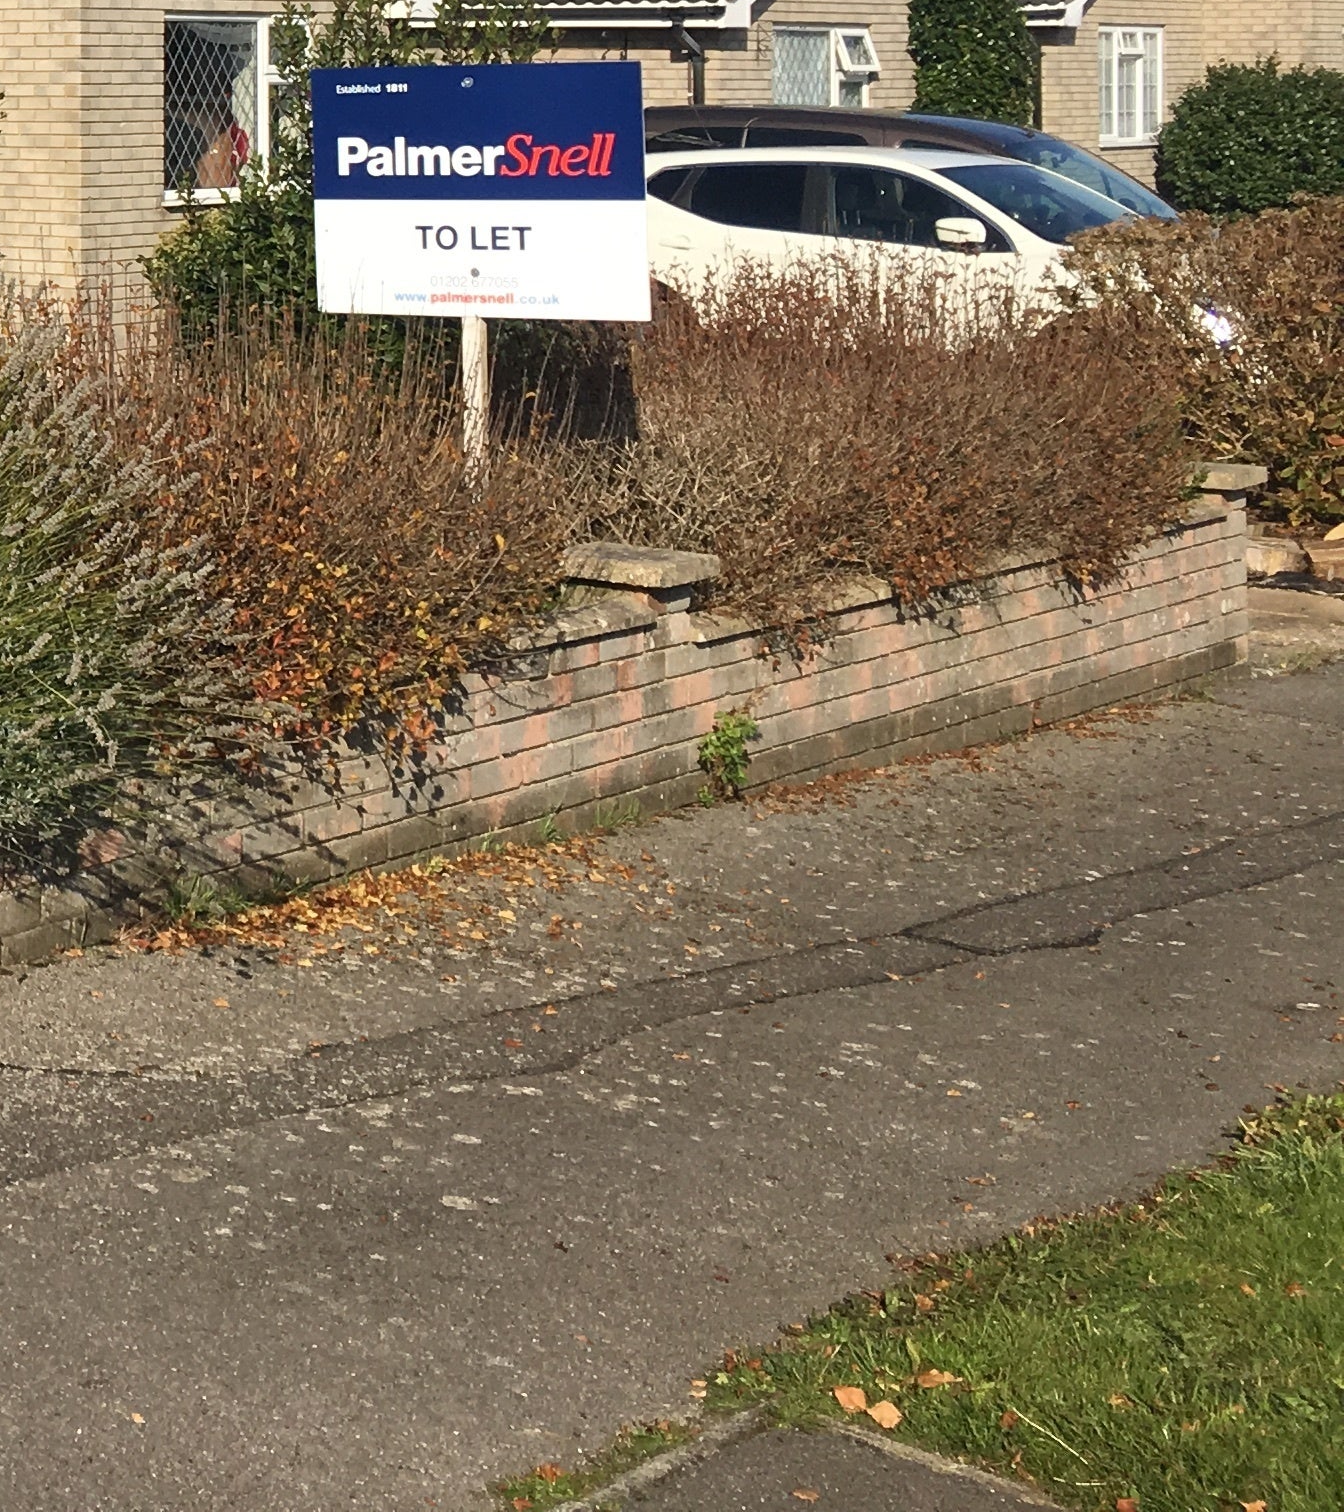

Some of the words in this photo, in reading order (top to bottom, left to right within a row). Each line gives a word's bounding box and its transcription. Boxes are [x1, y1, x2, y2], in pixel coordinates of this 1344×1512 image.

[336, 84, 381, 94] Established
[385, 83, 408, 93] 1811
[337, 133, 616, 177] PalmerSnell
[415, 225, 458, 250] TO
[470, 226, 532, 250] LET
[430, 275, 468, 288] 01202
[471, 276, 519, 288] 677055
[394, 292, 560, 306] www.palmersnell.co.uk
